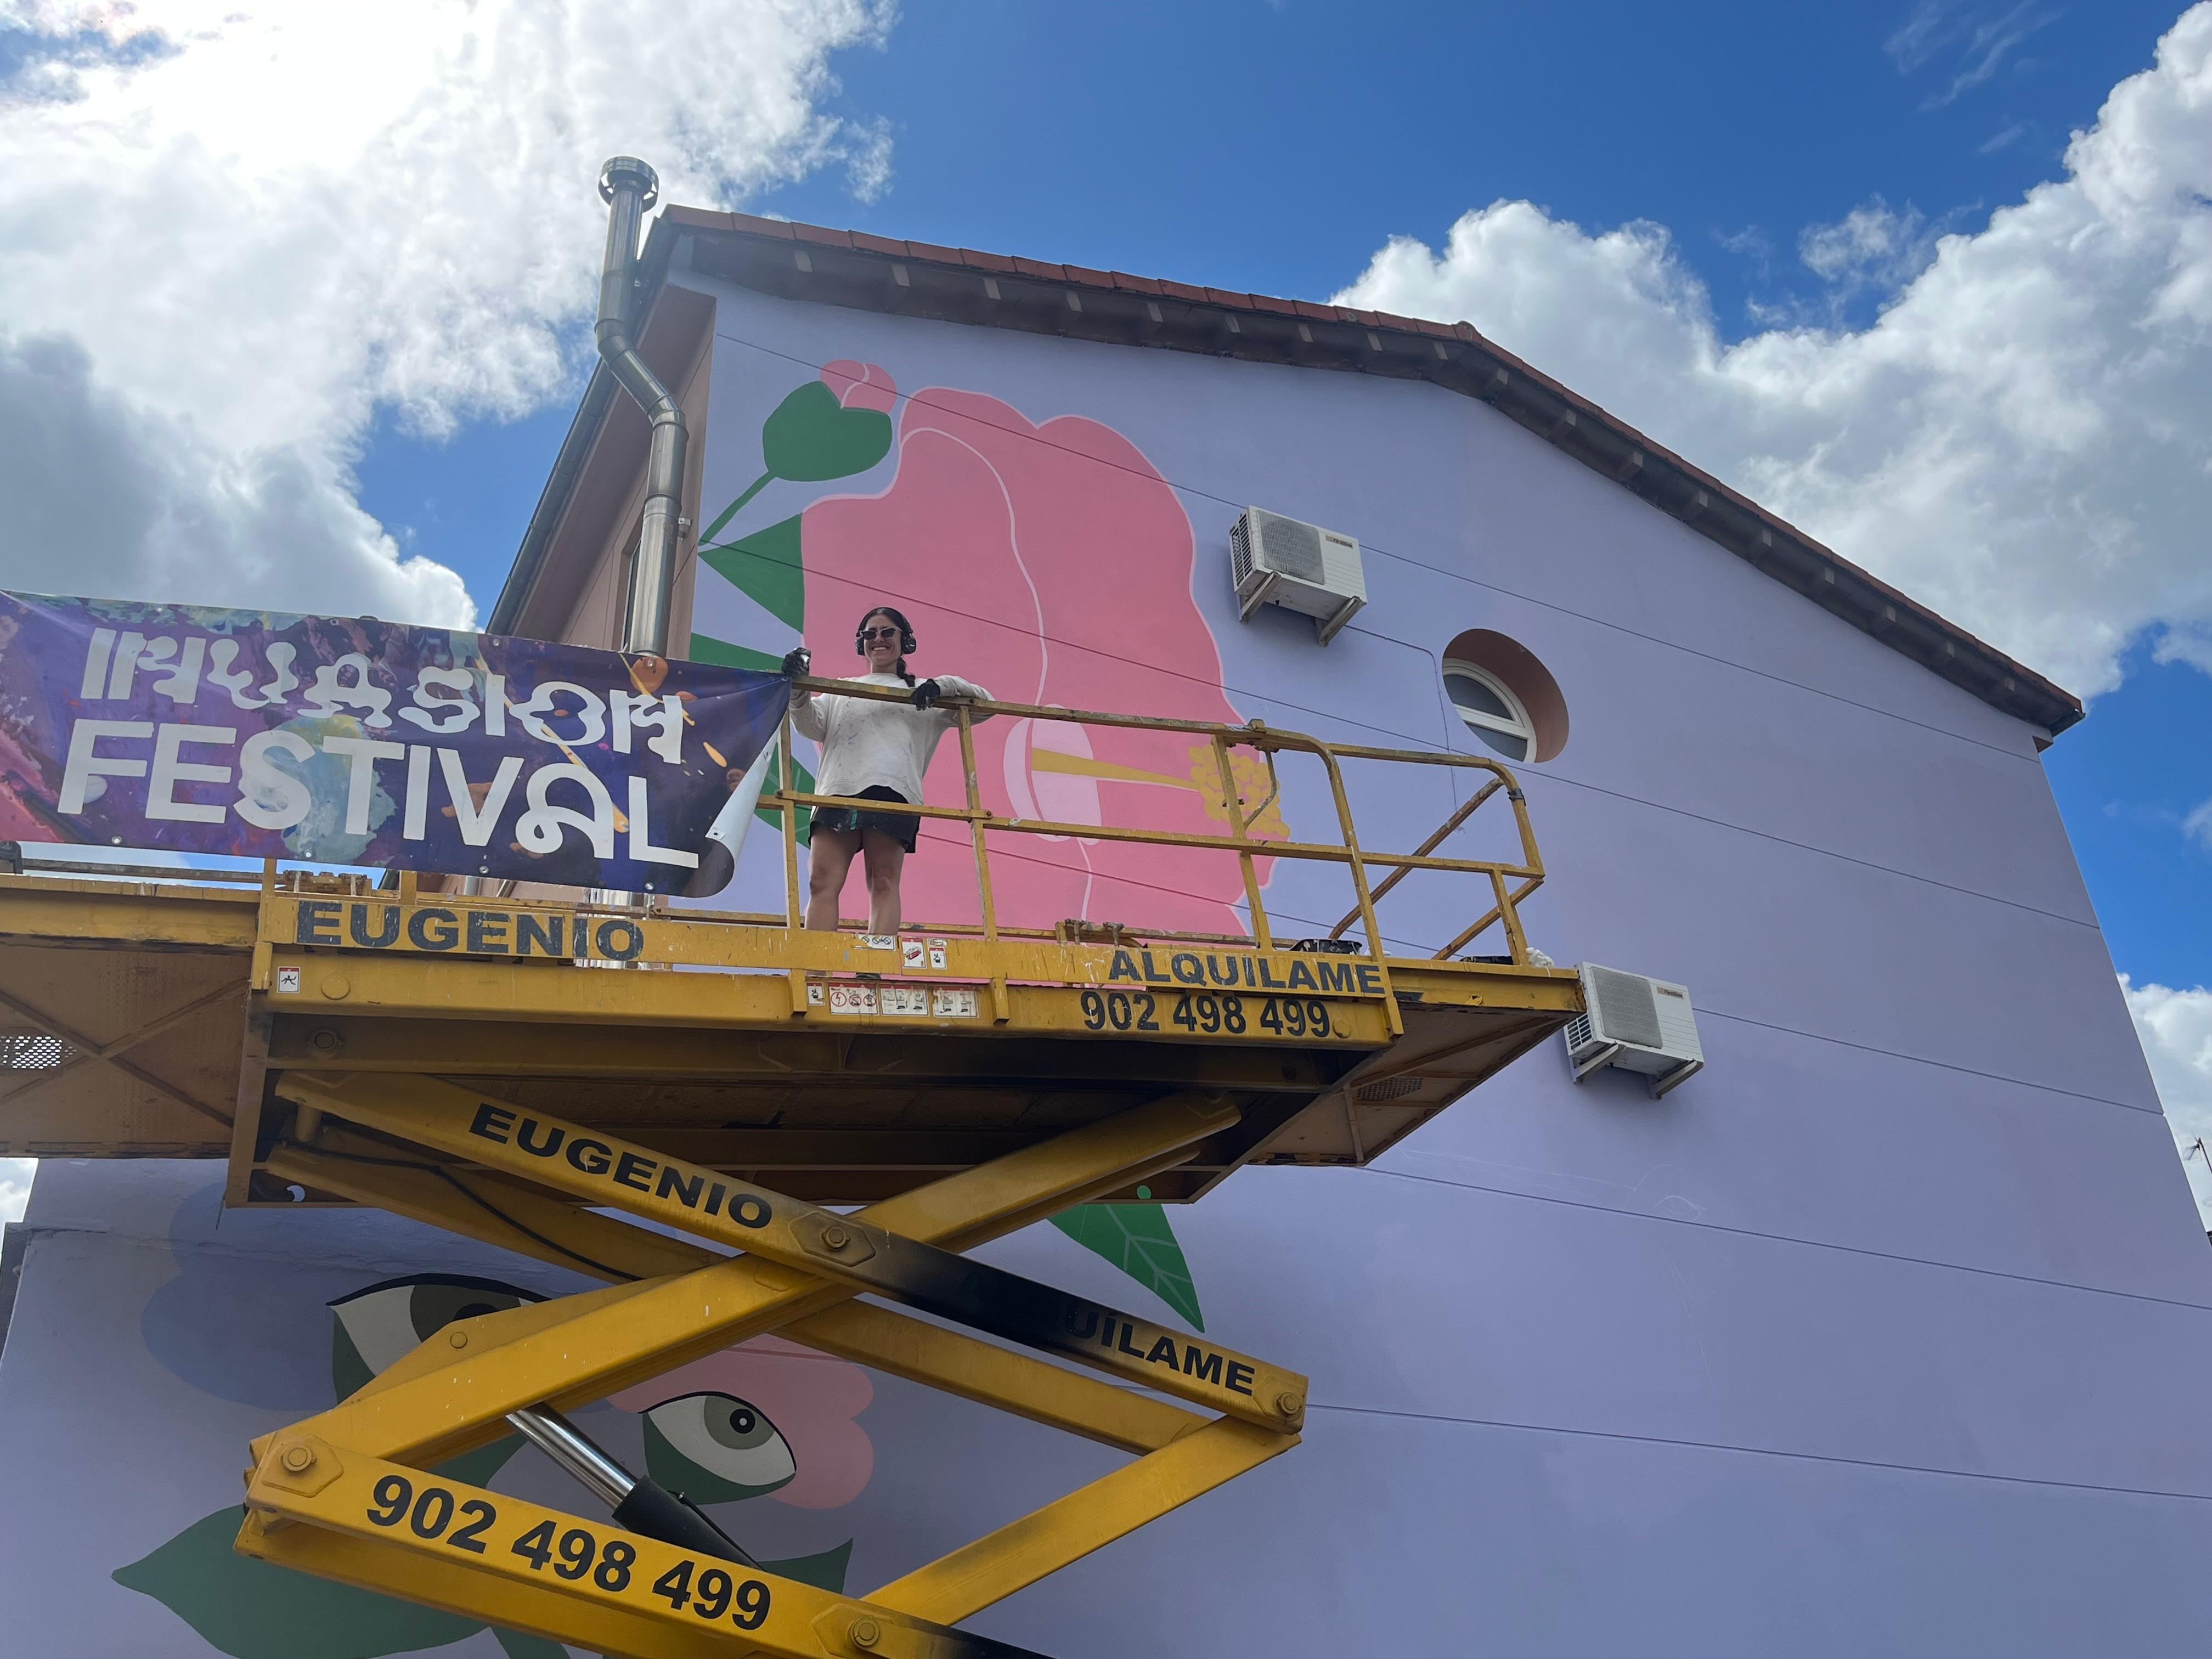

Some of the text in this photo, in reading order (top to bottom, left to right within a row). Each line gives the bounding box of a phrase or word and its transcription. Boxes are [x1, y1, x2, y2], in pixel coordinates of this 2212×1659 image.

[57, 718, 699, 869] FESTIVAL
[297, 900, 645, 961] EUGENIO
[1108, 950, 1385, 994] ALQUILAME
[1080, 991, 1330, 1038] 902 498 499
[469, 1103, 772, 1229] EUGENIO
[366, 1474, 772, 1632] 902 498 499
